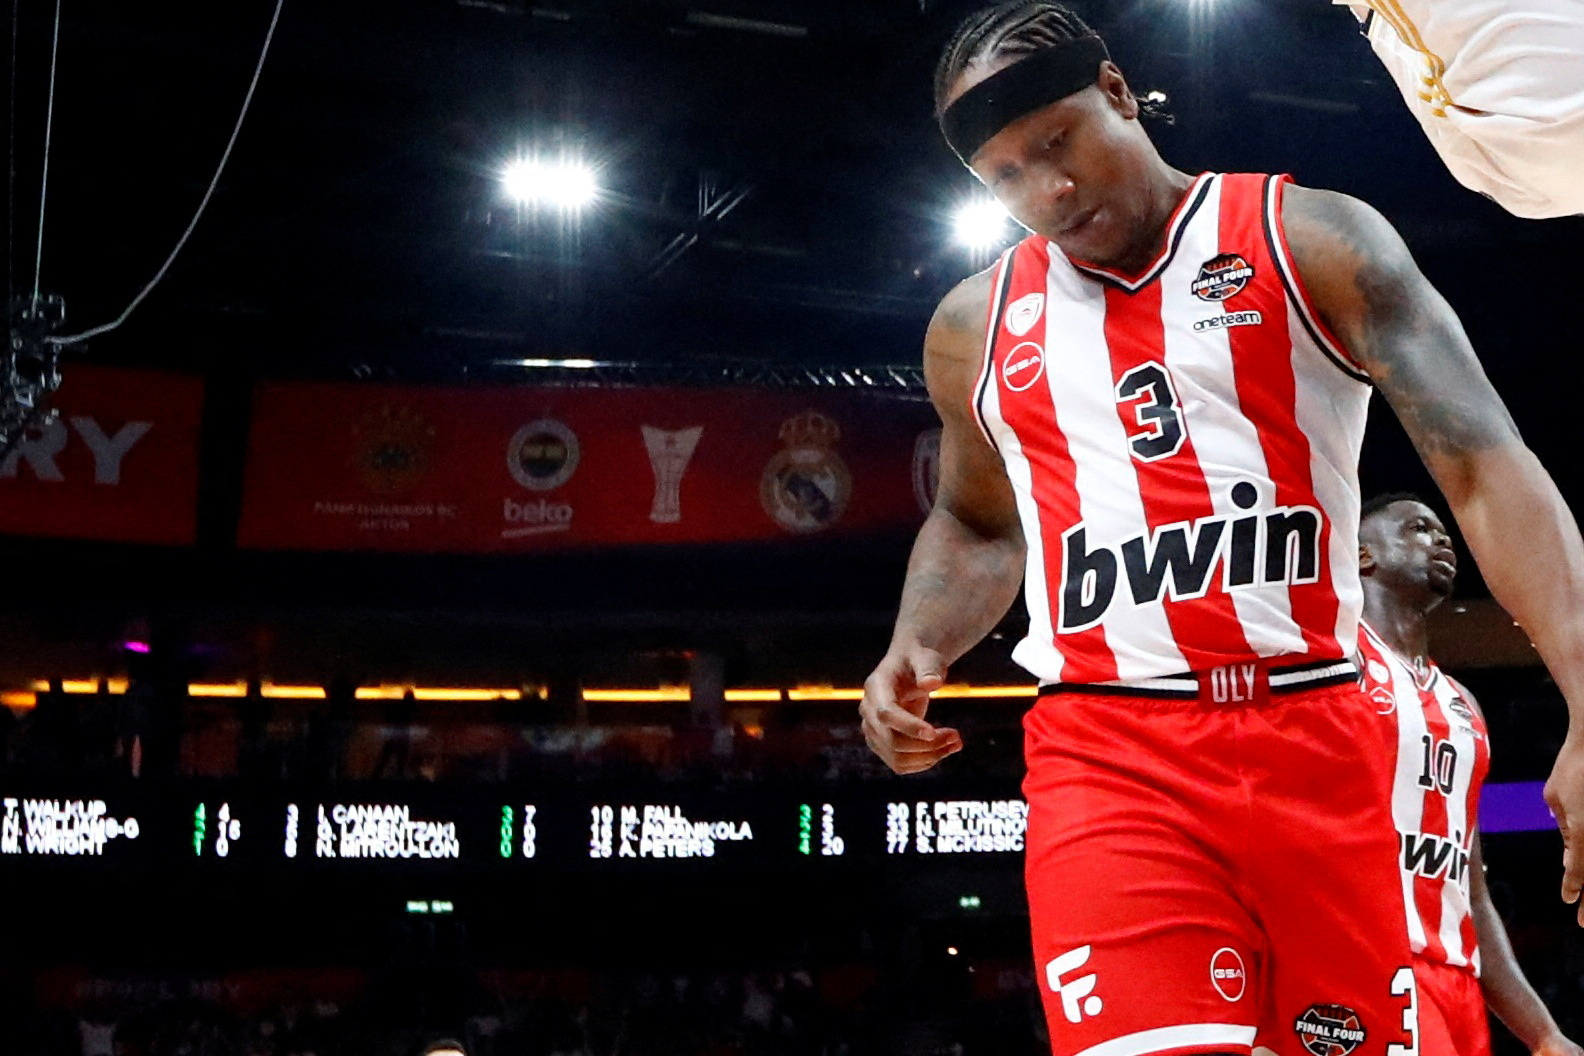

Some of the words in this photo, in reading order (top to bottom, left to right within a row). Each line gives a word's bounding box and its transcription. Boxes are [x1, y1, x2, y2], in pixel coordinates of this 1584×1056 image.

[1192, 276, 1222, 292] FINAL
[1223, 267, 1253, 282] FOUR
[1193, 313, 1260, 330] oneteam
[1117, 361, 1187, 462] 3
[503, 497, 574, 523] beko
[1061, 480, 1322, 631] bwin
[1211, 664, 1256, 703] OLY
[1418, 734, 1458, 795] 10
[24, 799, 106, 820] WALKUP
[333, 804, 409, 824] CANAAN
[591, 805, 613, 824] 10
[644, 805, 688, 825] FALL
[640, 839, 715, 858] PETERS
[1214, 968, 1243, 979] GSA
[1387, 966, 1420, 1056] 3
[1296, 1021, 1330, 1037] FINAL
[1333, 1028, 1365, 1042] FOUR
